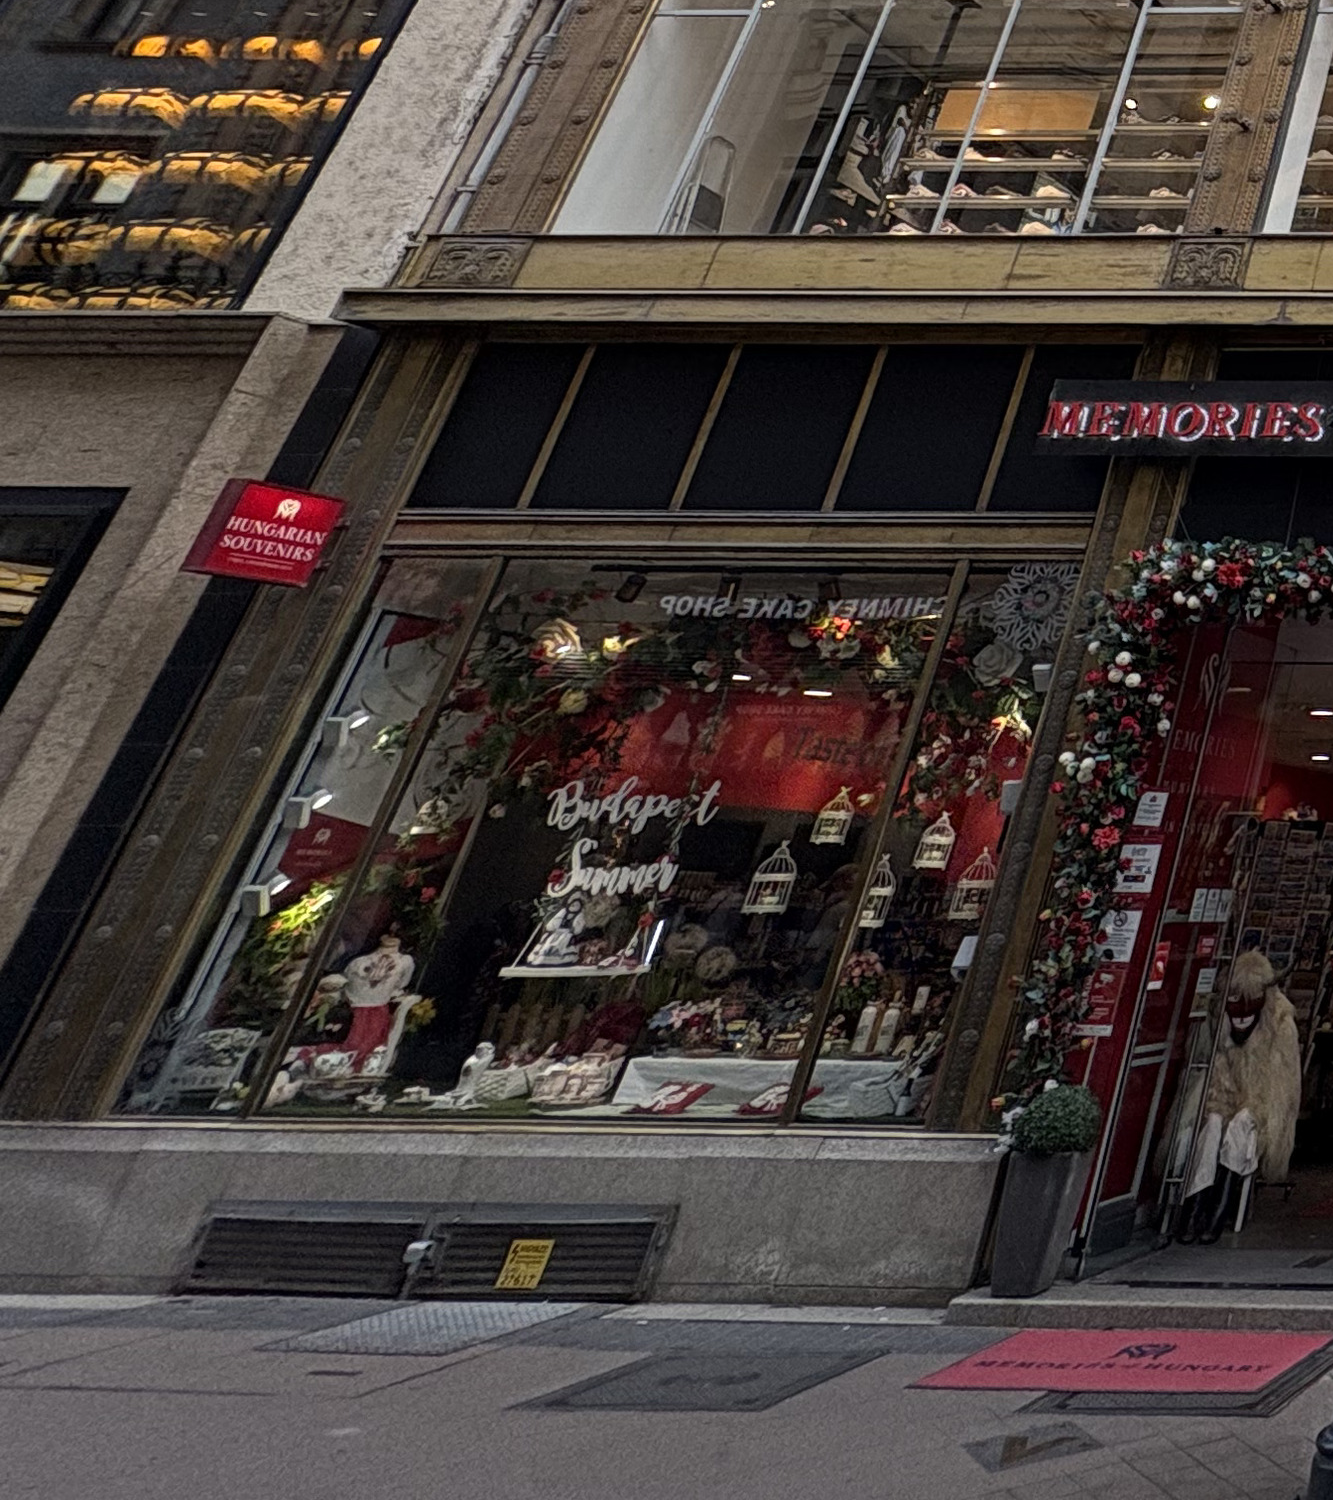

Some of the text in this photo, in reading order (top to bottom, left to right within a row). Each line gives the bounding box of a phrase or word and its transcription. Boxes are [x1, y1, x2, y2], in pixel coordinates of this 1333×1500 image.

[1038, 402, 1324, 441] MEMORIES
[226, 515, 328, 545] HUNGARIAN
[219, 534, 316, 562] SOUVENIRS
[547, 837, 680, 899] Summer
[972, 1360, 1115, 1370] MEMORIES
[1142, 1361, 1271, 1373] HUNGARY
